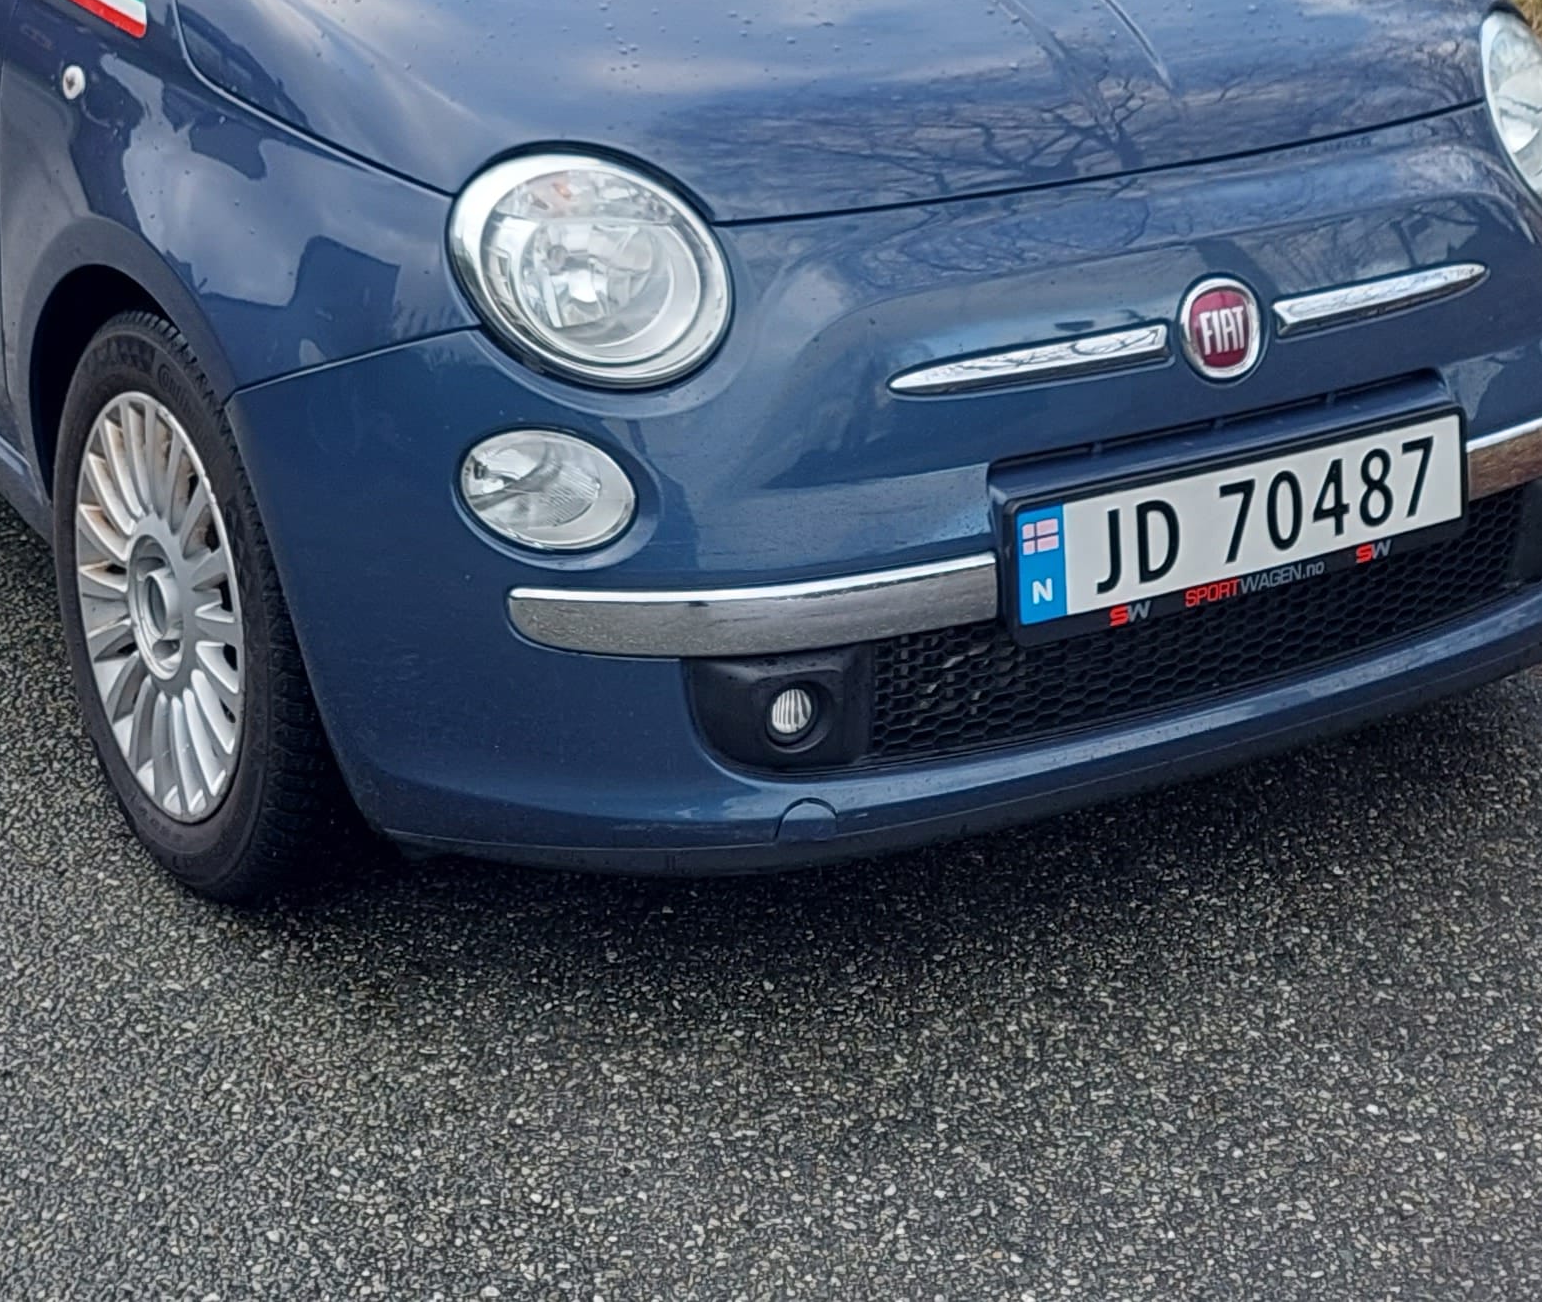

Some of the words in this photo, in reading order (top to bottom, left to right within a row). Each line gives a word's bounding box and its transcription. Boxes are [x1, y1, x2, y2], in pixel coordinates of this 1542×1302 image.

[1199, 305, 1245, 356] FIAT
[1096, 499, 1180, 595] JD
[1219, 435, 1434, 565] 70487
[1031, 577, 1054, 605] N
[1109, 600, 1151, 627] SW
[1184, 560, 1325, 607] SPORTWAGEN.no
[1355, 539, 1392, 564] SW
